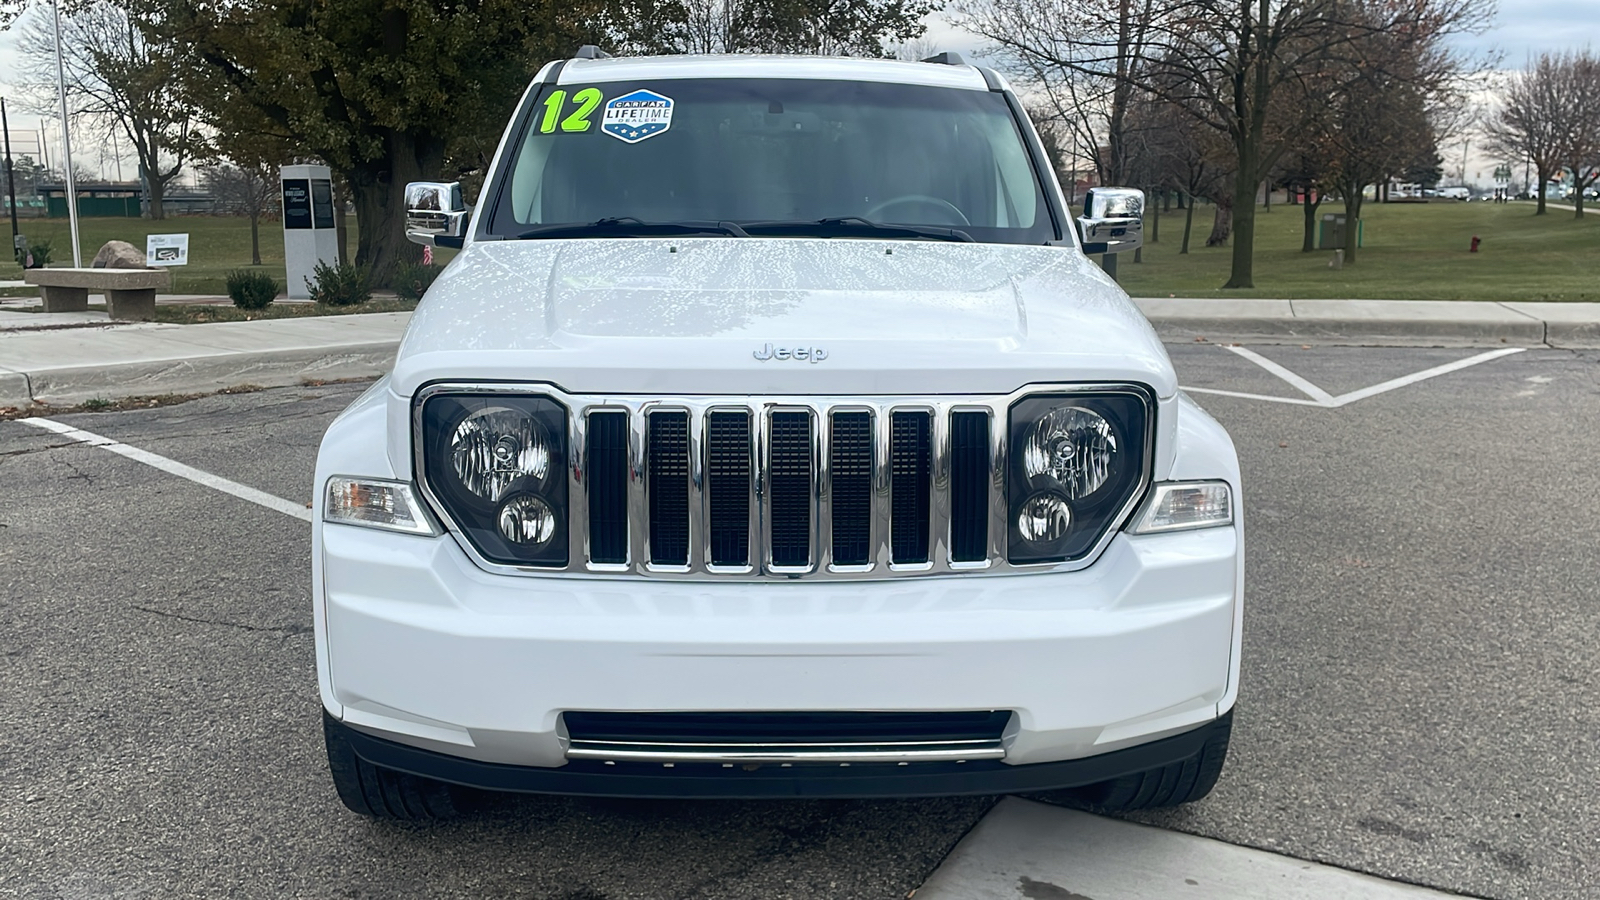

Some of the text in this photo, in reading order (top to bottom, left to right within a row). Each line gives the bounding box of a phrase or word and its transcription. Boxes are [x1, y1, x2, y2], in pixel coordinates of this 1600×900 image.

[540, 88, 603, 133] 12
[606, 109, 670, 118] LIFETIME
[753, 343, 829, 364] Jeep
